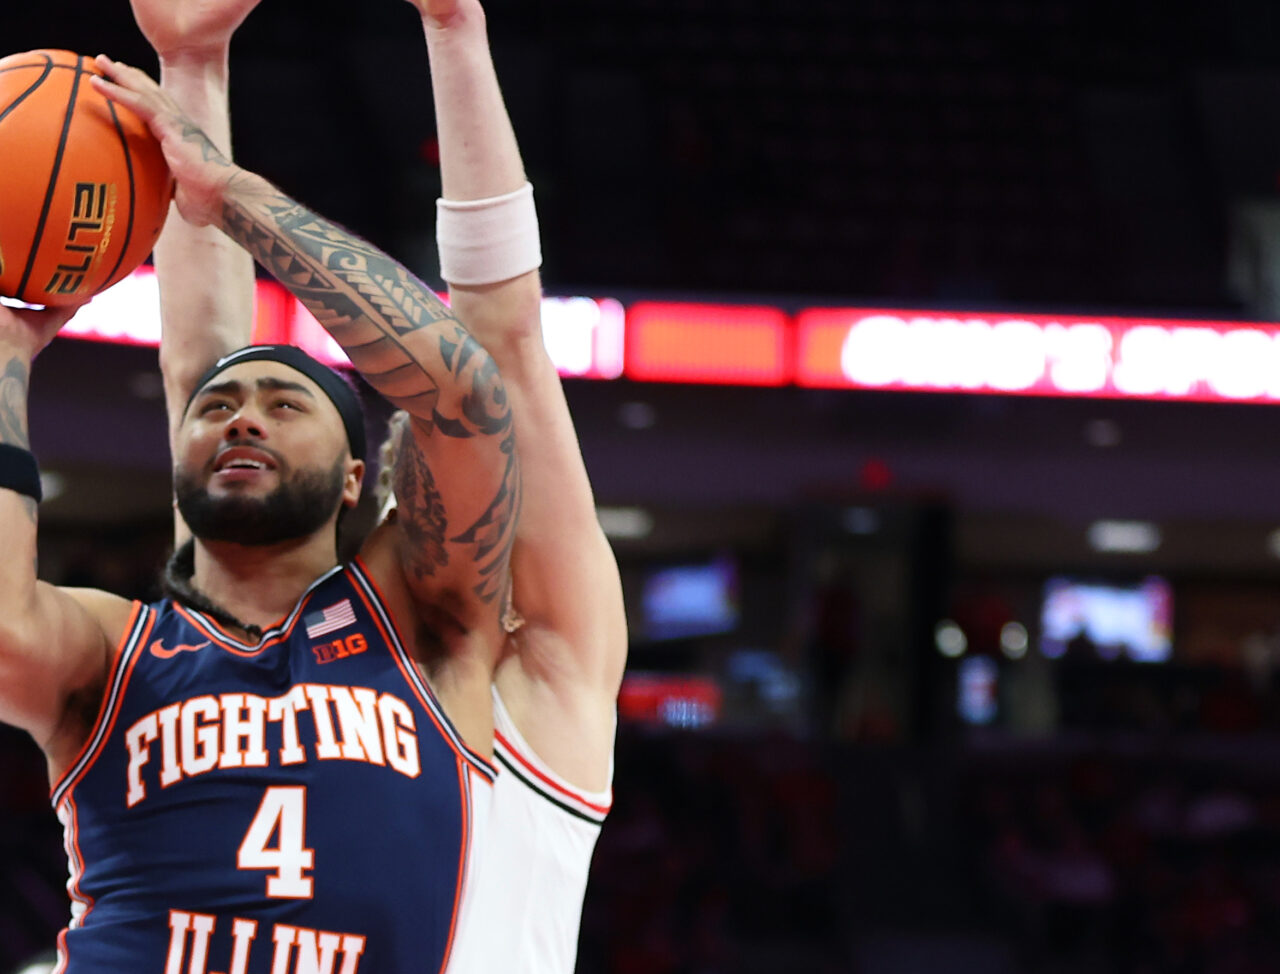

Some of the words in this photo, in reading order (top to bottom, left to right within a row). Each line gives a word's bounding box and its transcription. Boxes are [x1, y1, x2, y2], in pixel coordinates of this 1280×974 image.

[44, 182, 108, 294] ELITE
[125, 683, 421, 809] FIGHTING
[237, 786, 314, 898] 4
